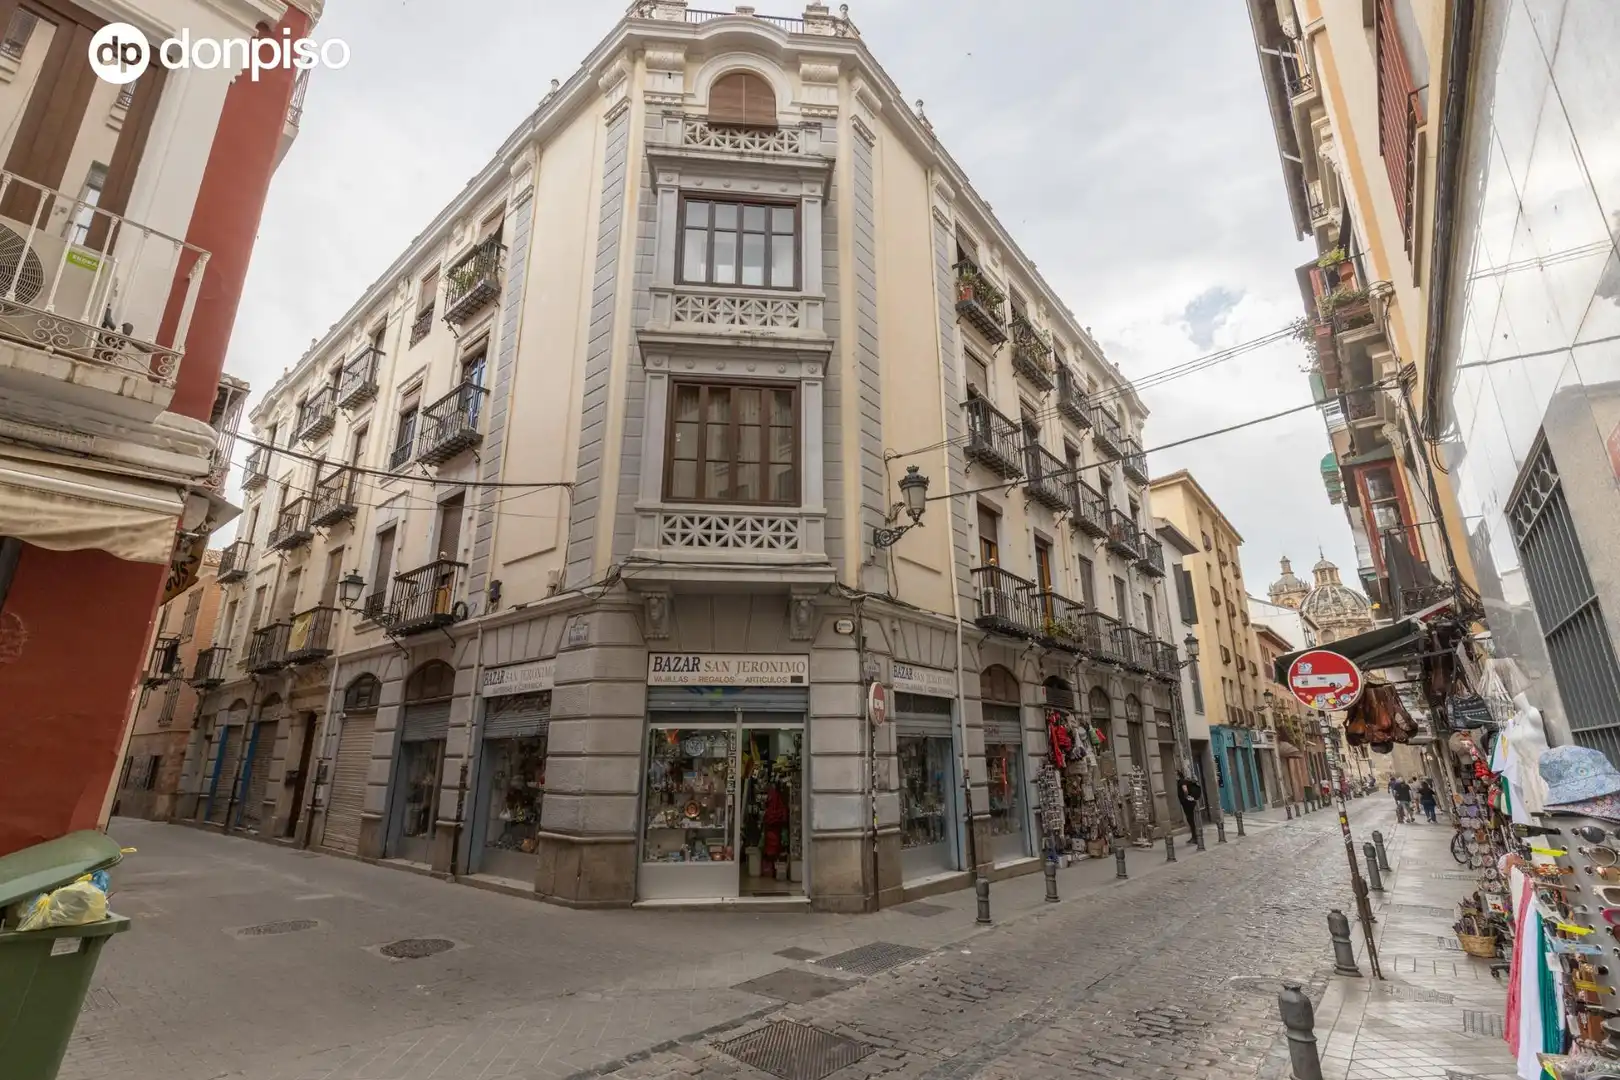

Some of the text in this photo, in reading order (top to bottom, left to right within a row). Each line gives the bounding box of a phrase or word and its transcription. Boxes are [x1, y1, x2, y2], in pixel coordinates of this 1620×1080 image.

[652, 656, 806, 676] BAZAR SAN JERONIMO
[893, 665, 913, 680] BAZAR
[484, 670, 506, 687] BAZAR
[654, 675, 788, 684] VAJILLAS REGALOS ARTICULOS
